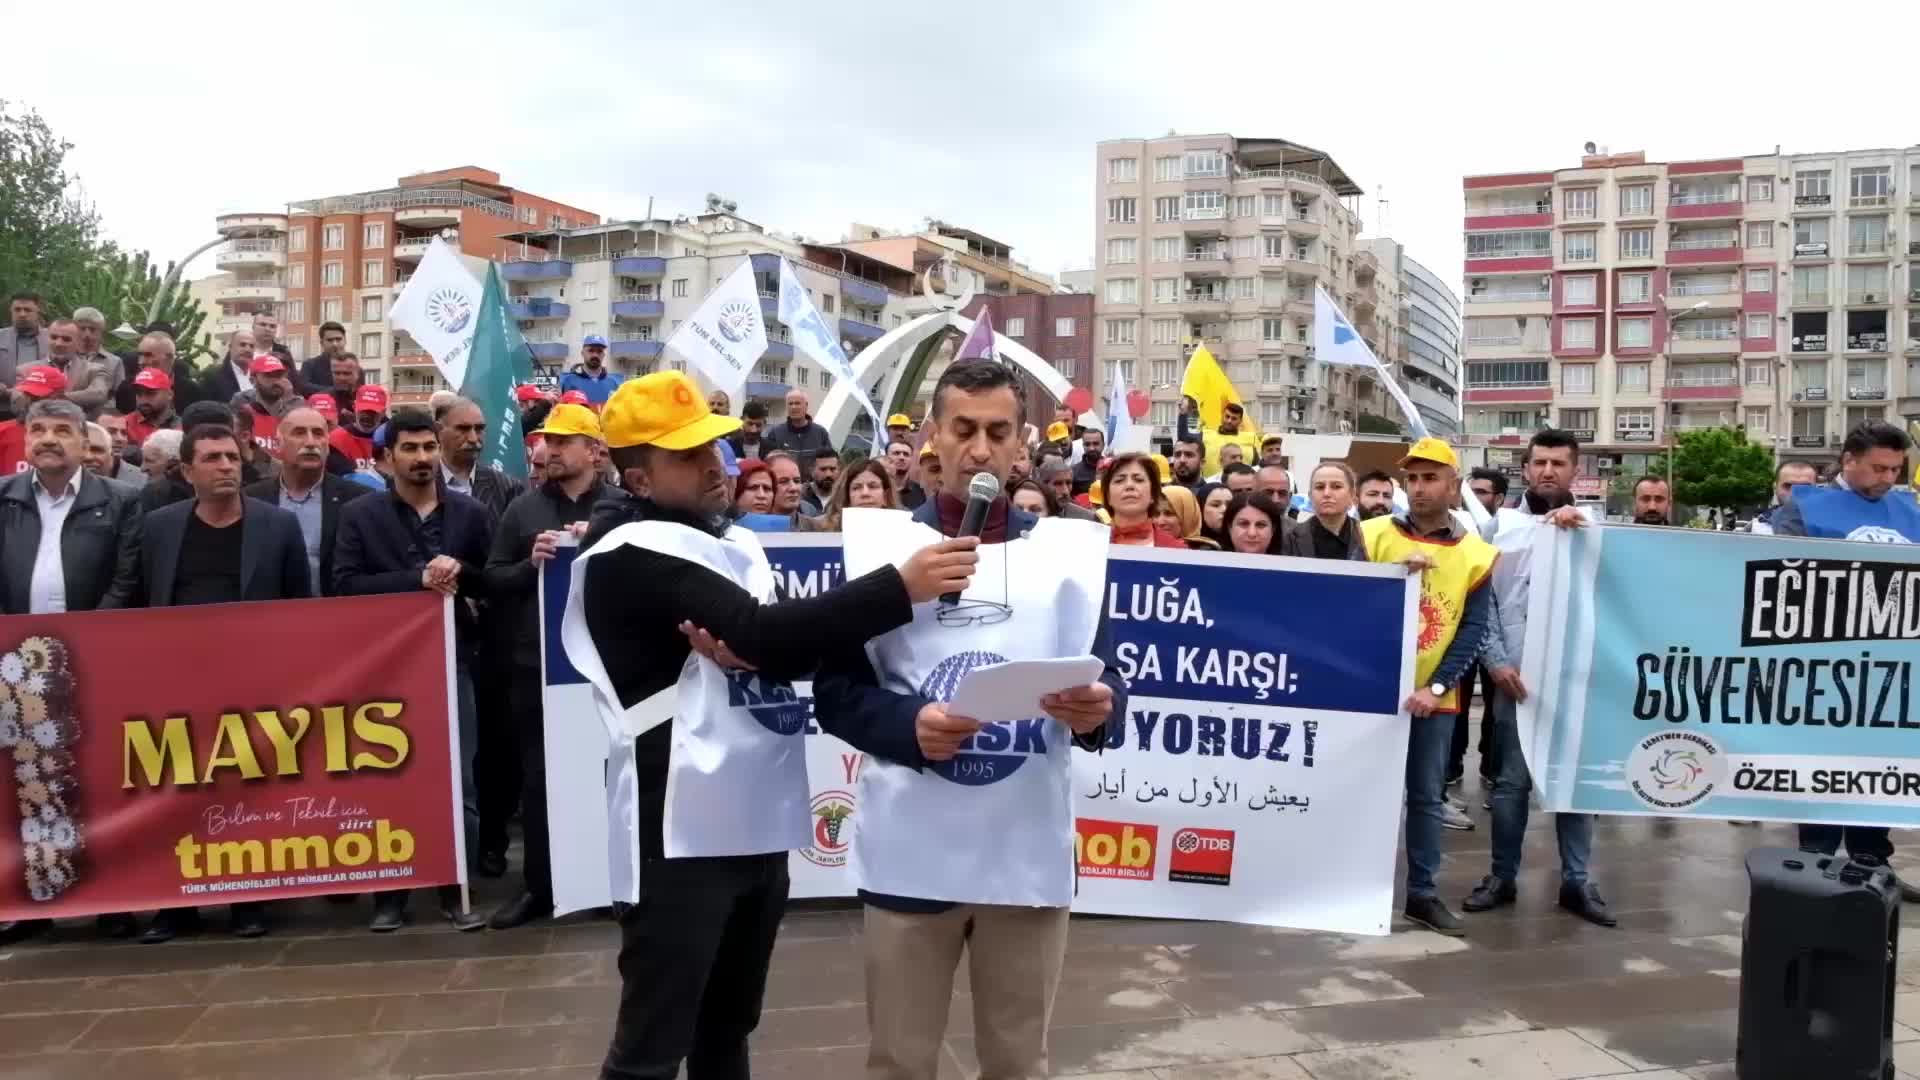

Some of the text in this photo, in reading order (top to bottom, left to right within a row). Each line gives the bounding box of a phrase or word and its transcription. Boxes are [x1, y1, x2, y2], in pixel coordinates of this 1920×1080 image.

[1175, 646, 1299, 700] KARŞI;
[121, 701, 409, 789] MAYIS
[952, 759, 995, 779] 1995
[1733, 762, 1920, 796] ÖZEL SEKTÖR
[1084, 768, 1310, 813] يعيش الأول من أيار
[175, 819, 415, 879] tmmob
[1201, 837, 1231, 851] TDB
[282, 876, 295, 887] VE
